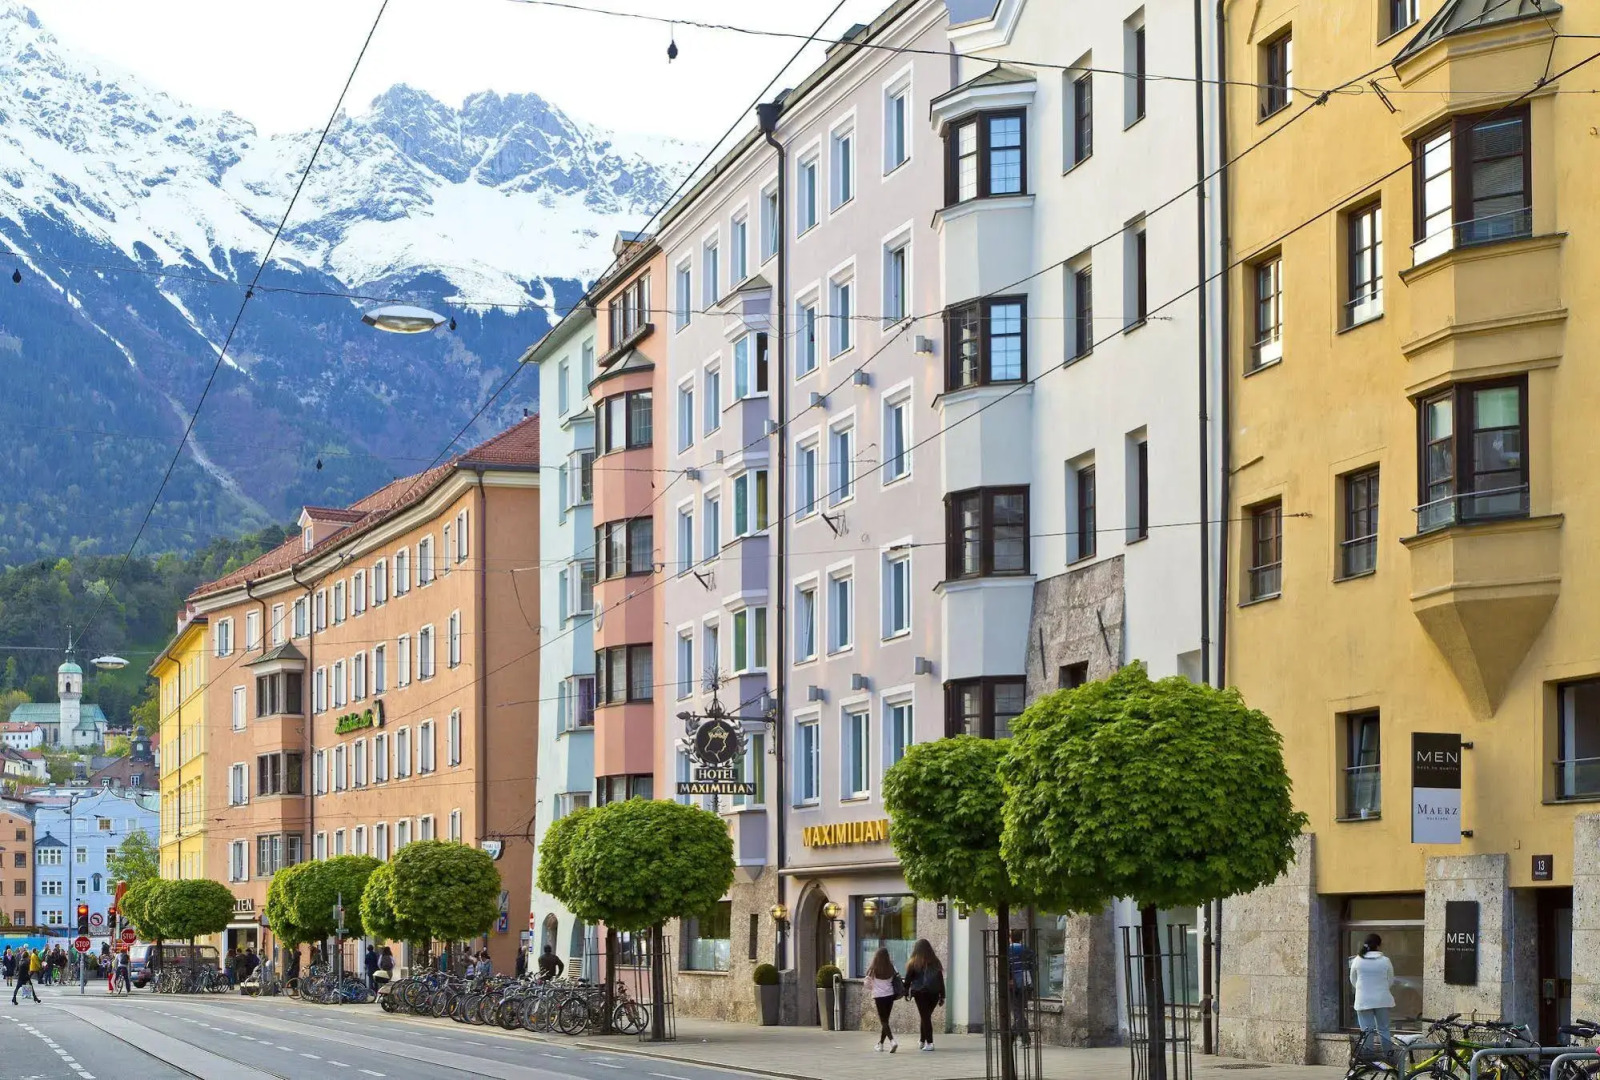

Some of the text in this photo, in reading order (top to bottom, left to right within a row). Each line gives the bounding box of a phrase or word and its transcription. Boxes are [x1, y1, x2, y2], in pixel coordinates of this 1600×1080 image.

[1416, 751, 1458, 763] MEN
[699, 769, 736, 779] HOTEL
[680, 783, 754, 794] MAXIMILIAN
[802, 819, 886, 847] MAXIMILIAN
[1538, 860, 1545, 871] 13
[1446, 932, 1475, 944] MEN
